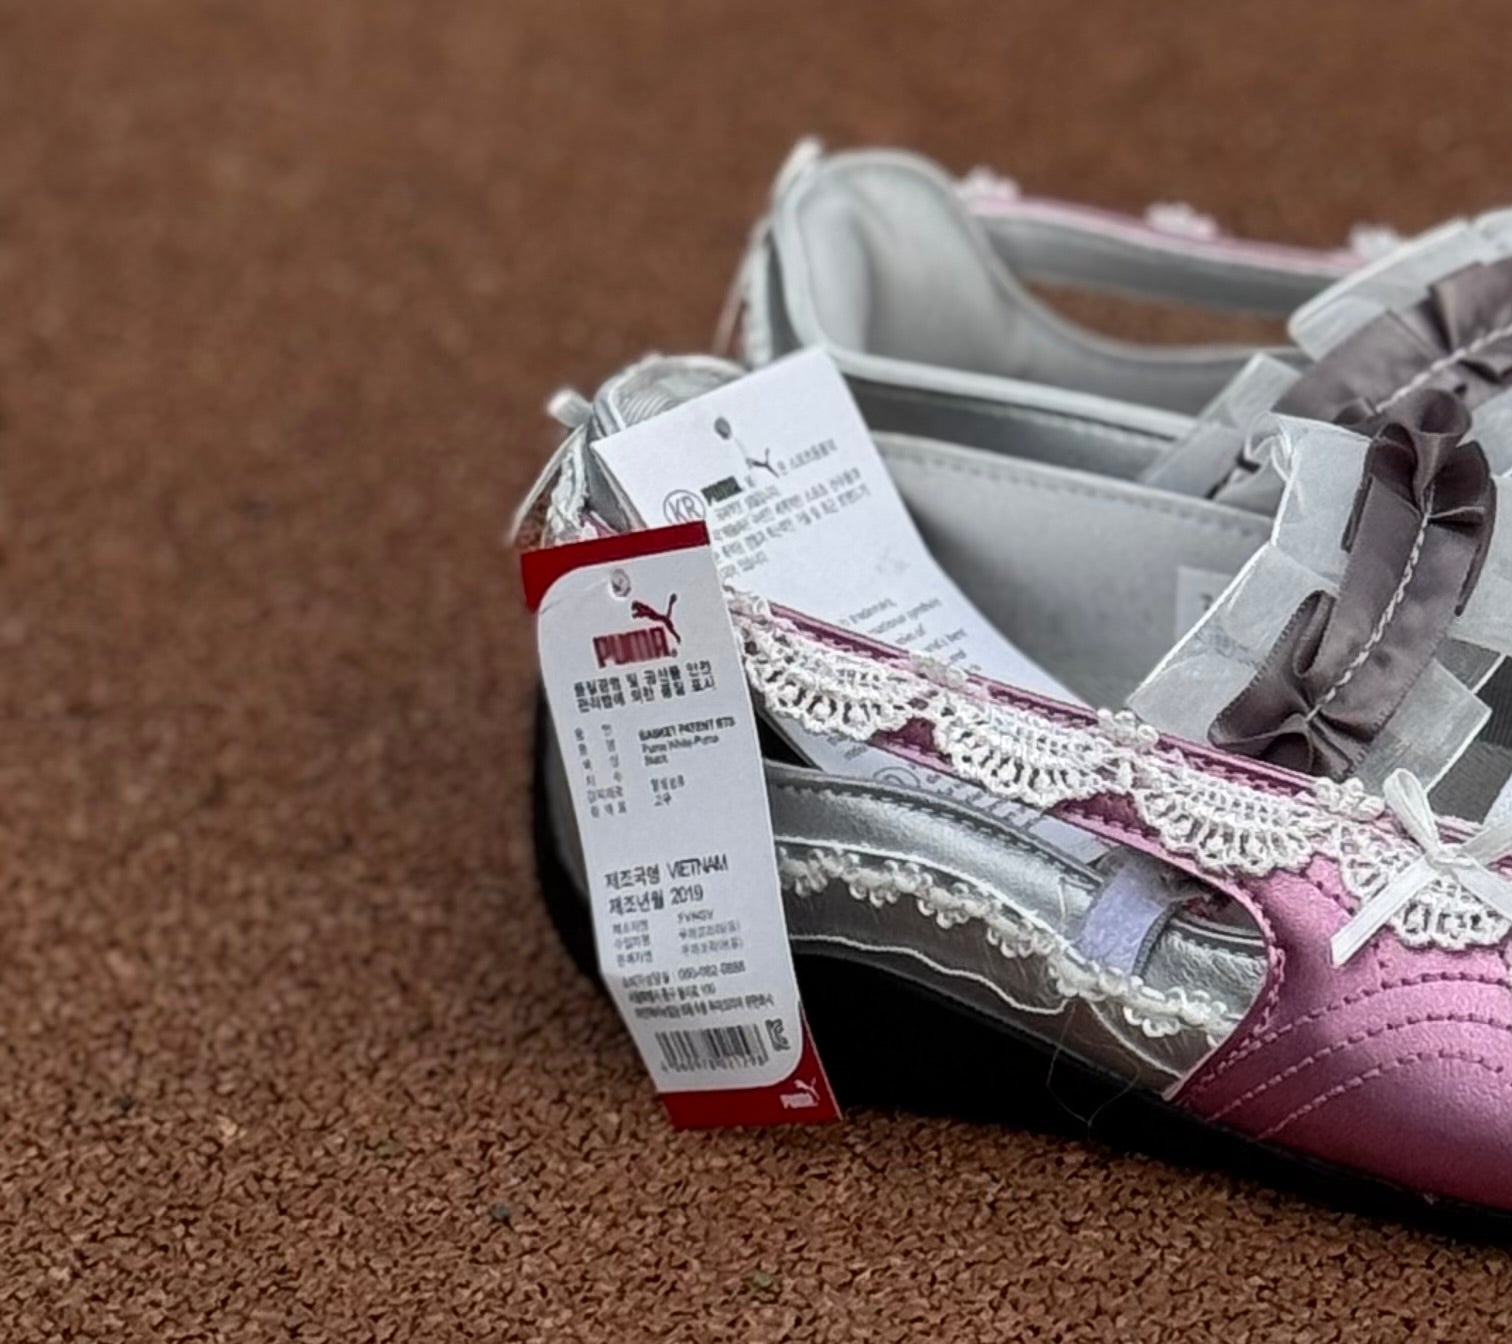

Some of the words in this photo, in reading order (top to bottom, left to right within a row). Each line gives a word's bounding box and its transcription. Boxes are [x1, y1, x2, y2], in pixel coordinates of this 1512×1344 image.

[593, 626, 669, 669] PUMA
[666, 853, 728, 879] VIETNAM
[671, 884, 703, 905] 2019
